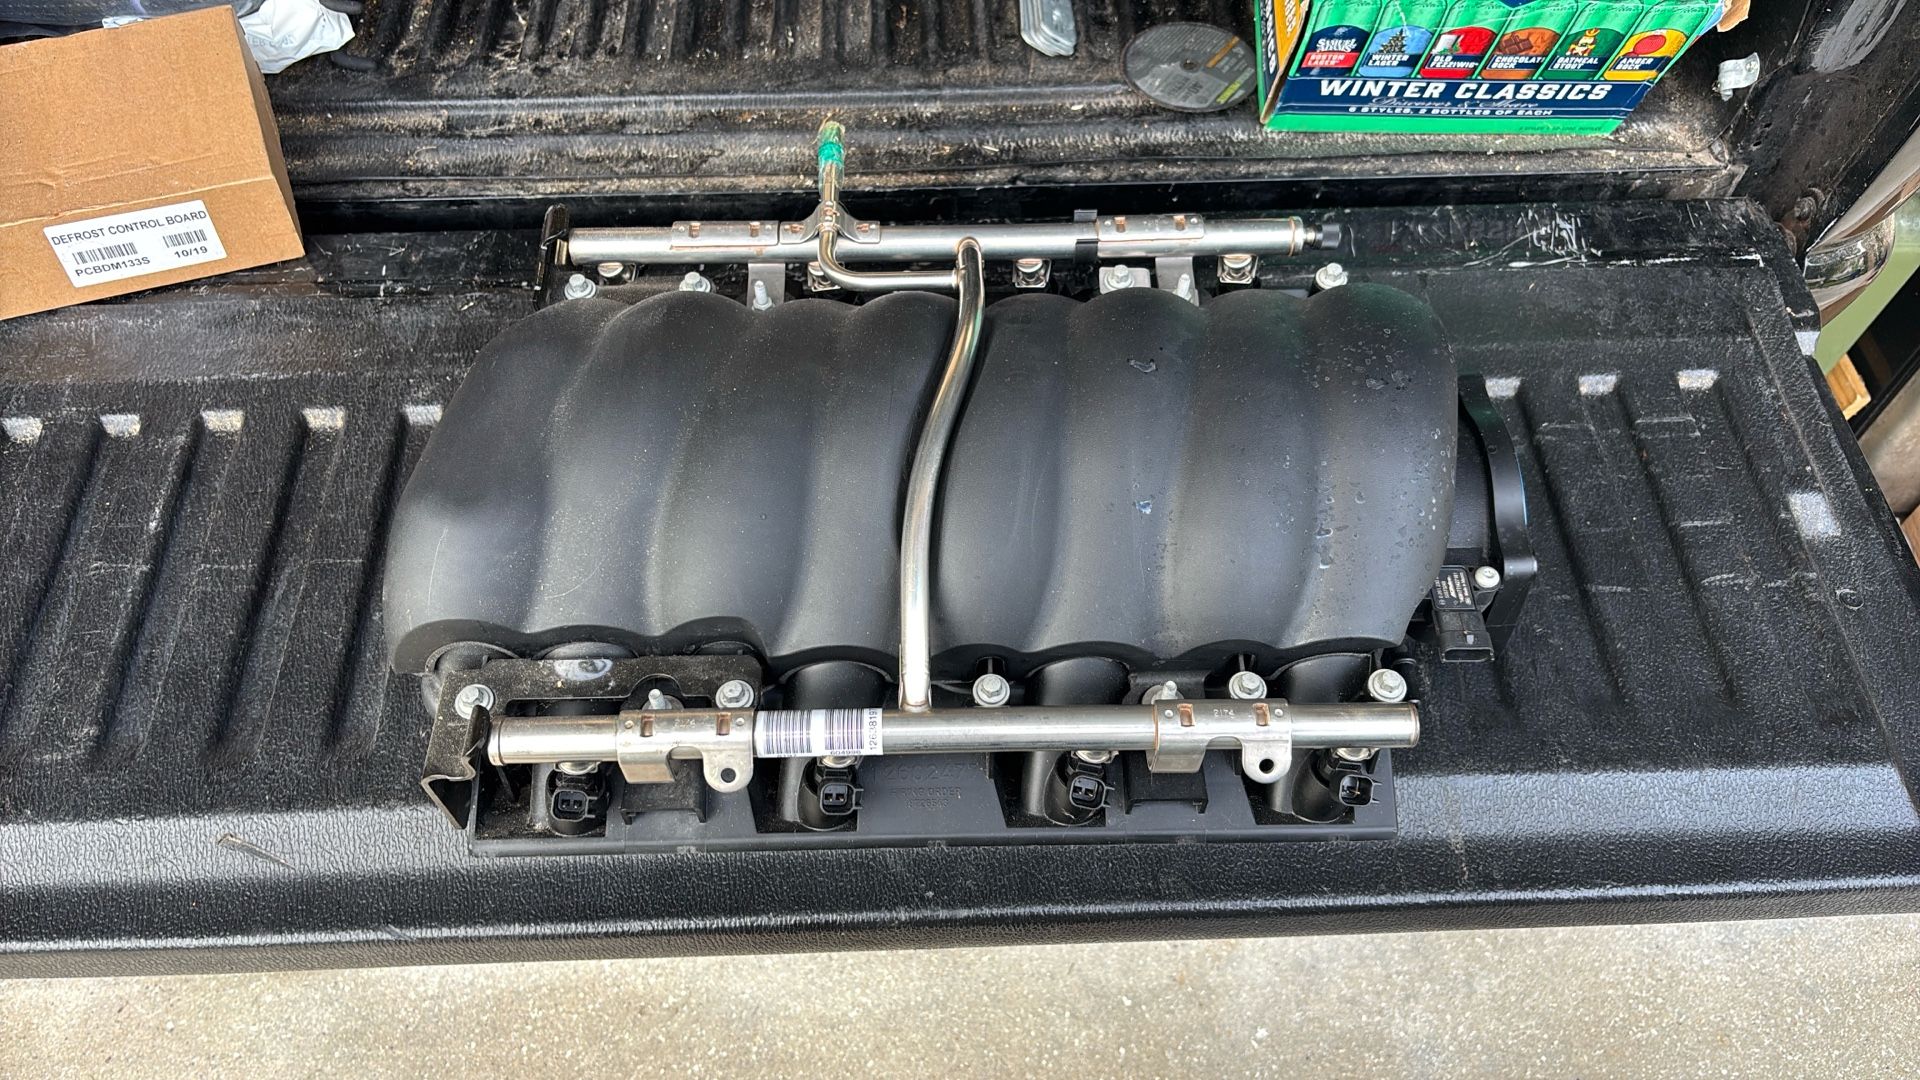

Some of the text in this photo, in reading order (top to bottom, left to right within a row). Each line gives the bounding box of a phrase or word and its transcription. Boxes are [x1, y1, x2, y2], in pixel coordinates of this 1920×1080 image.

[1320, 79, 1613, 100] WINTER CLASSICS
[1361, 107, 1413, 115] STYLES,
[1431, 108, 1490, 116] BOTTLES
[51, 210, 208, 246] DEFROST CONTROL BOARD
[74, 245, 208, 277] PCBDM133S 10/19
[927, 786, 962, 798] ORDER
